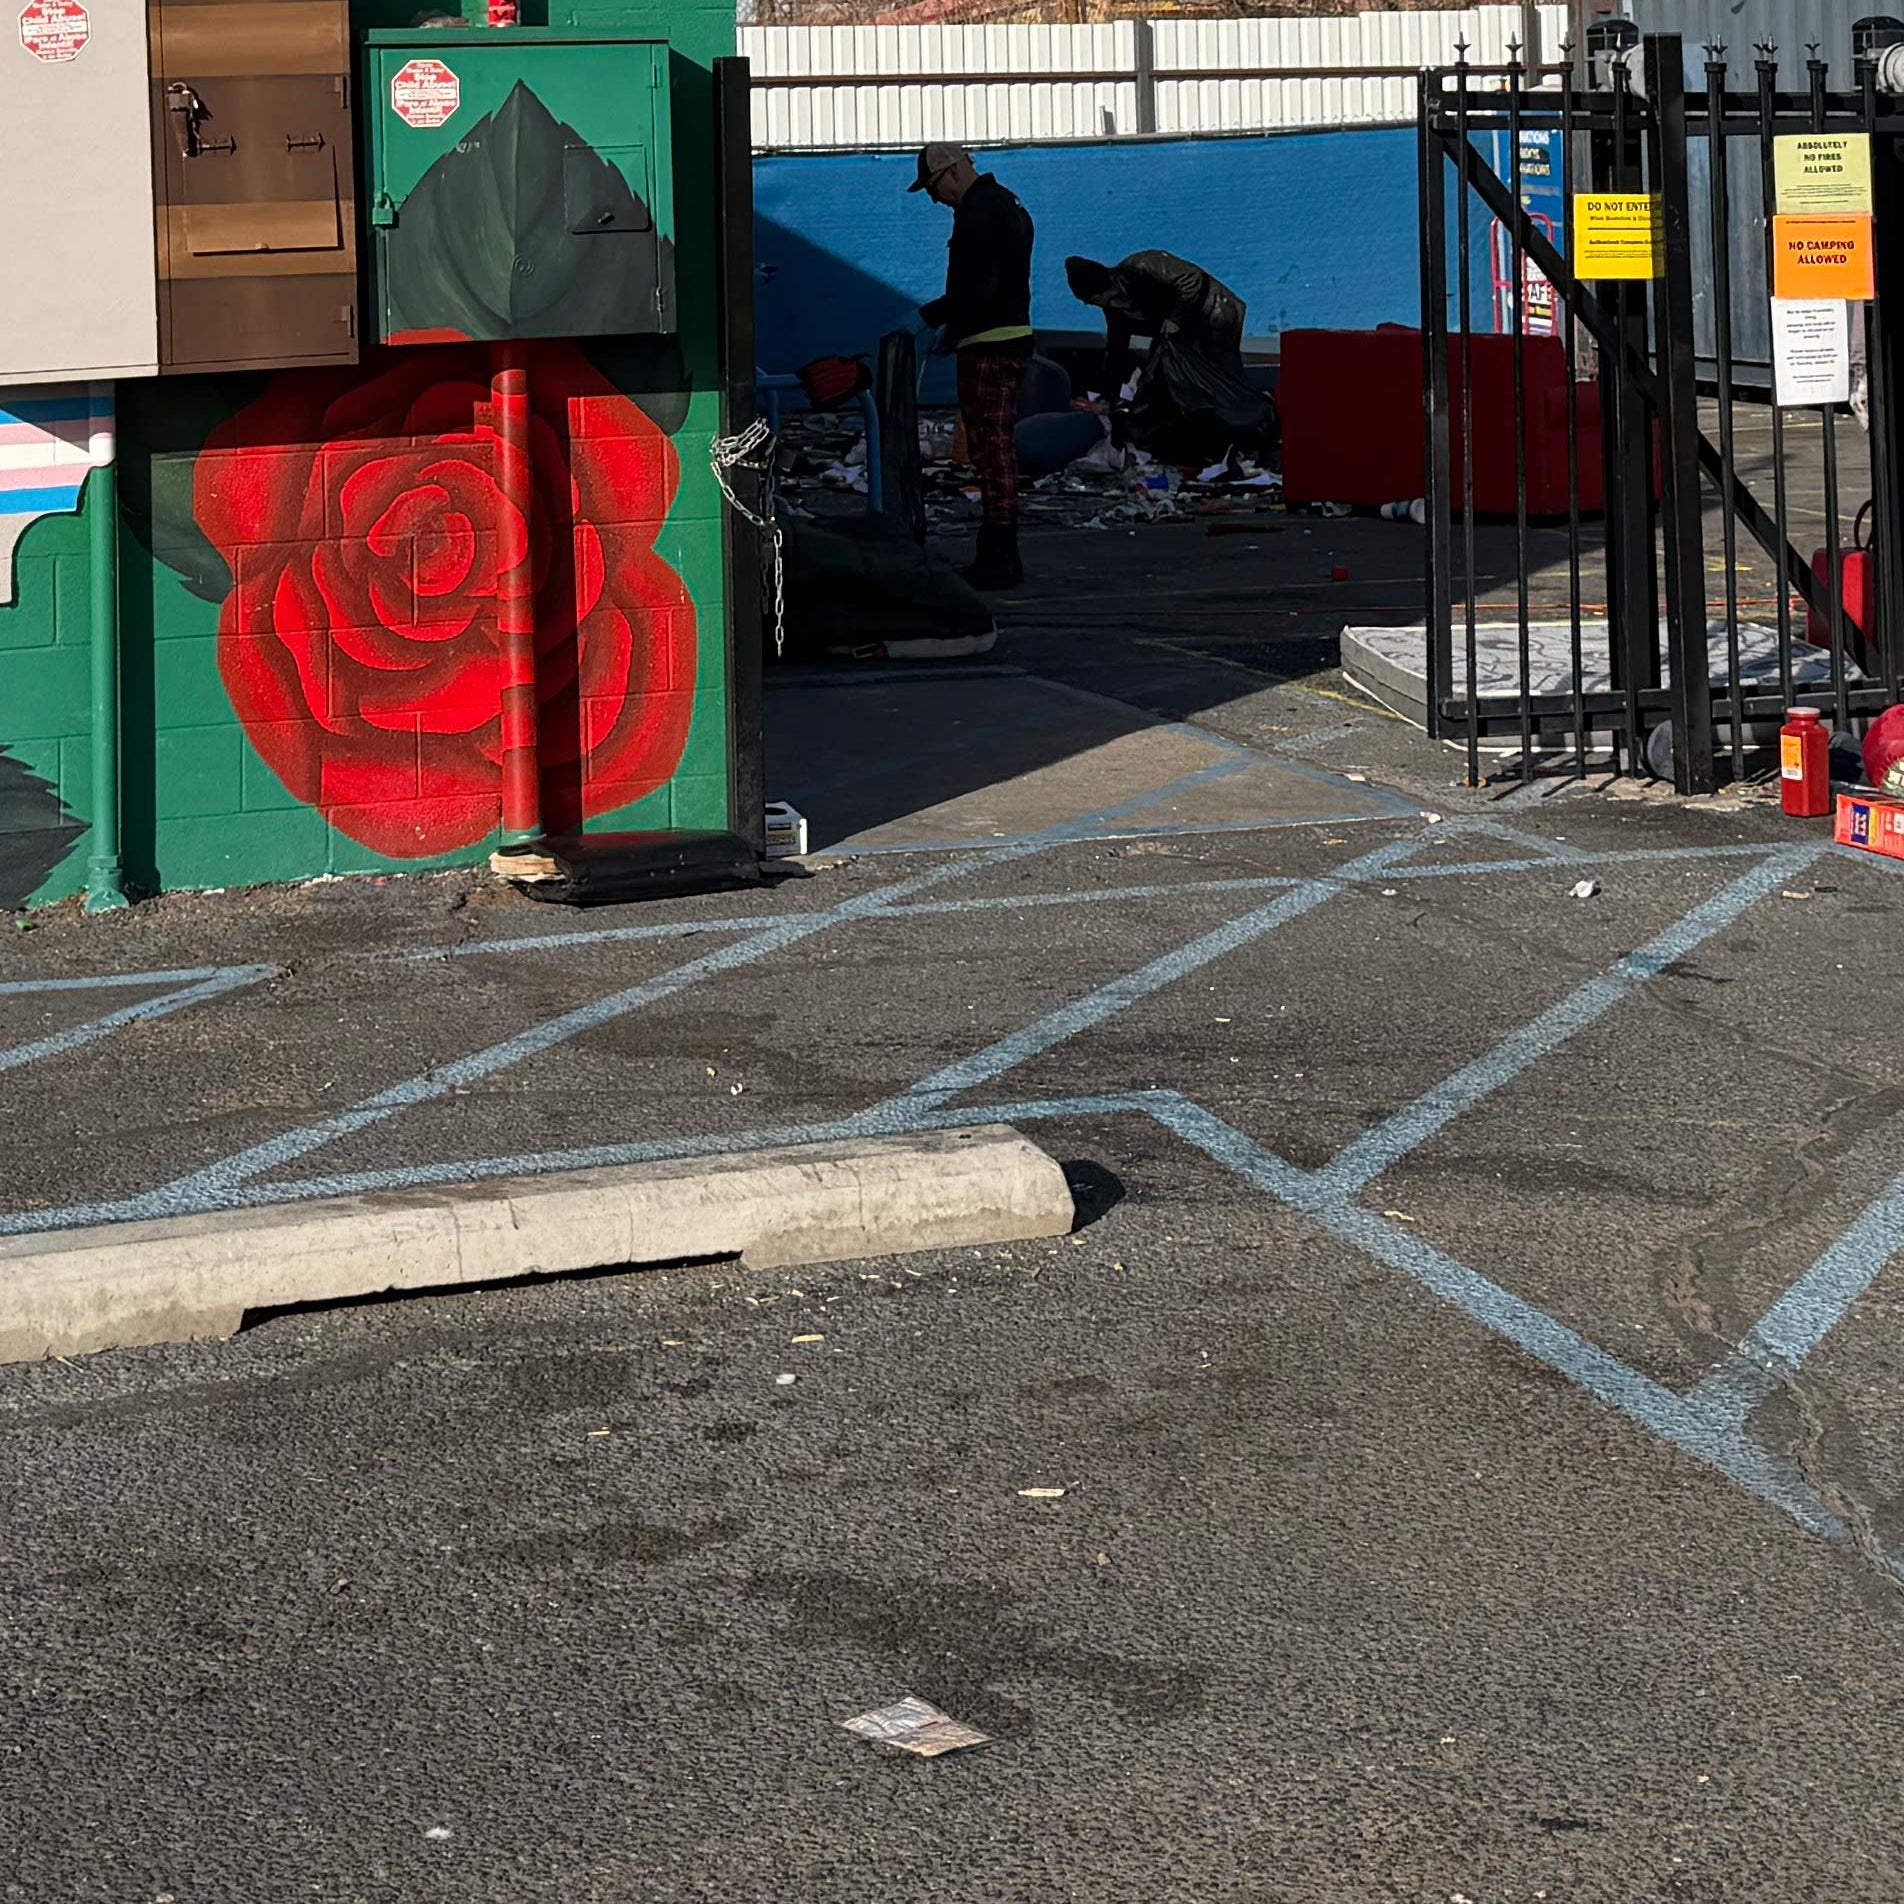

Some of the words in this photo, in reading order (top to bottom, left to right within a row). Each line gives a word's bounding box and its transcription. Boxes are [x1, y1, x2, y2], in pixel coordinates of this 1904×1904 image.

[1797, 140, 1848, 150] ABSOLUTELY
[1804, 153, 1816, 162] NO
[1817, 152, 1842, 161] FIRES
[1803, 165, 1844, 174] ALLOWED
[1587, 201, 1602, 211] DO
[1604, 201, 1623, 212] NOT
[1788, 241, 1804, 251] NO
[1806, 240, 1855, 251] CAMPING
[1797, 254, 1847, 265] ALLOWED
